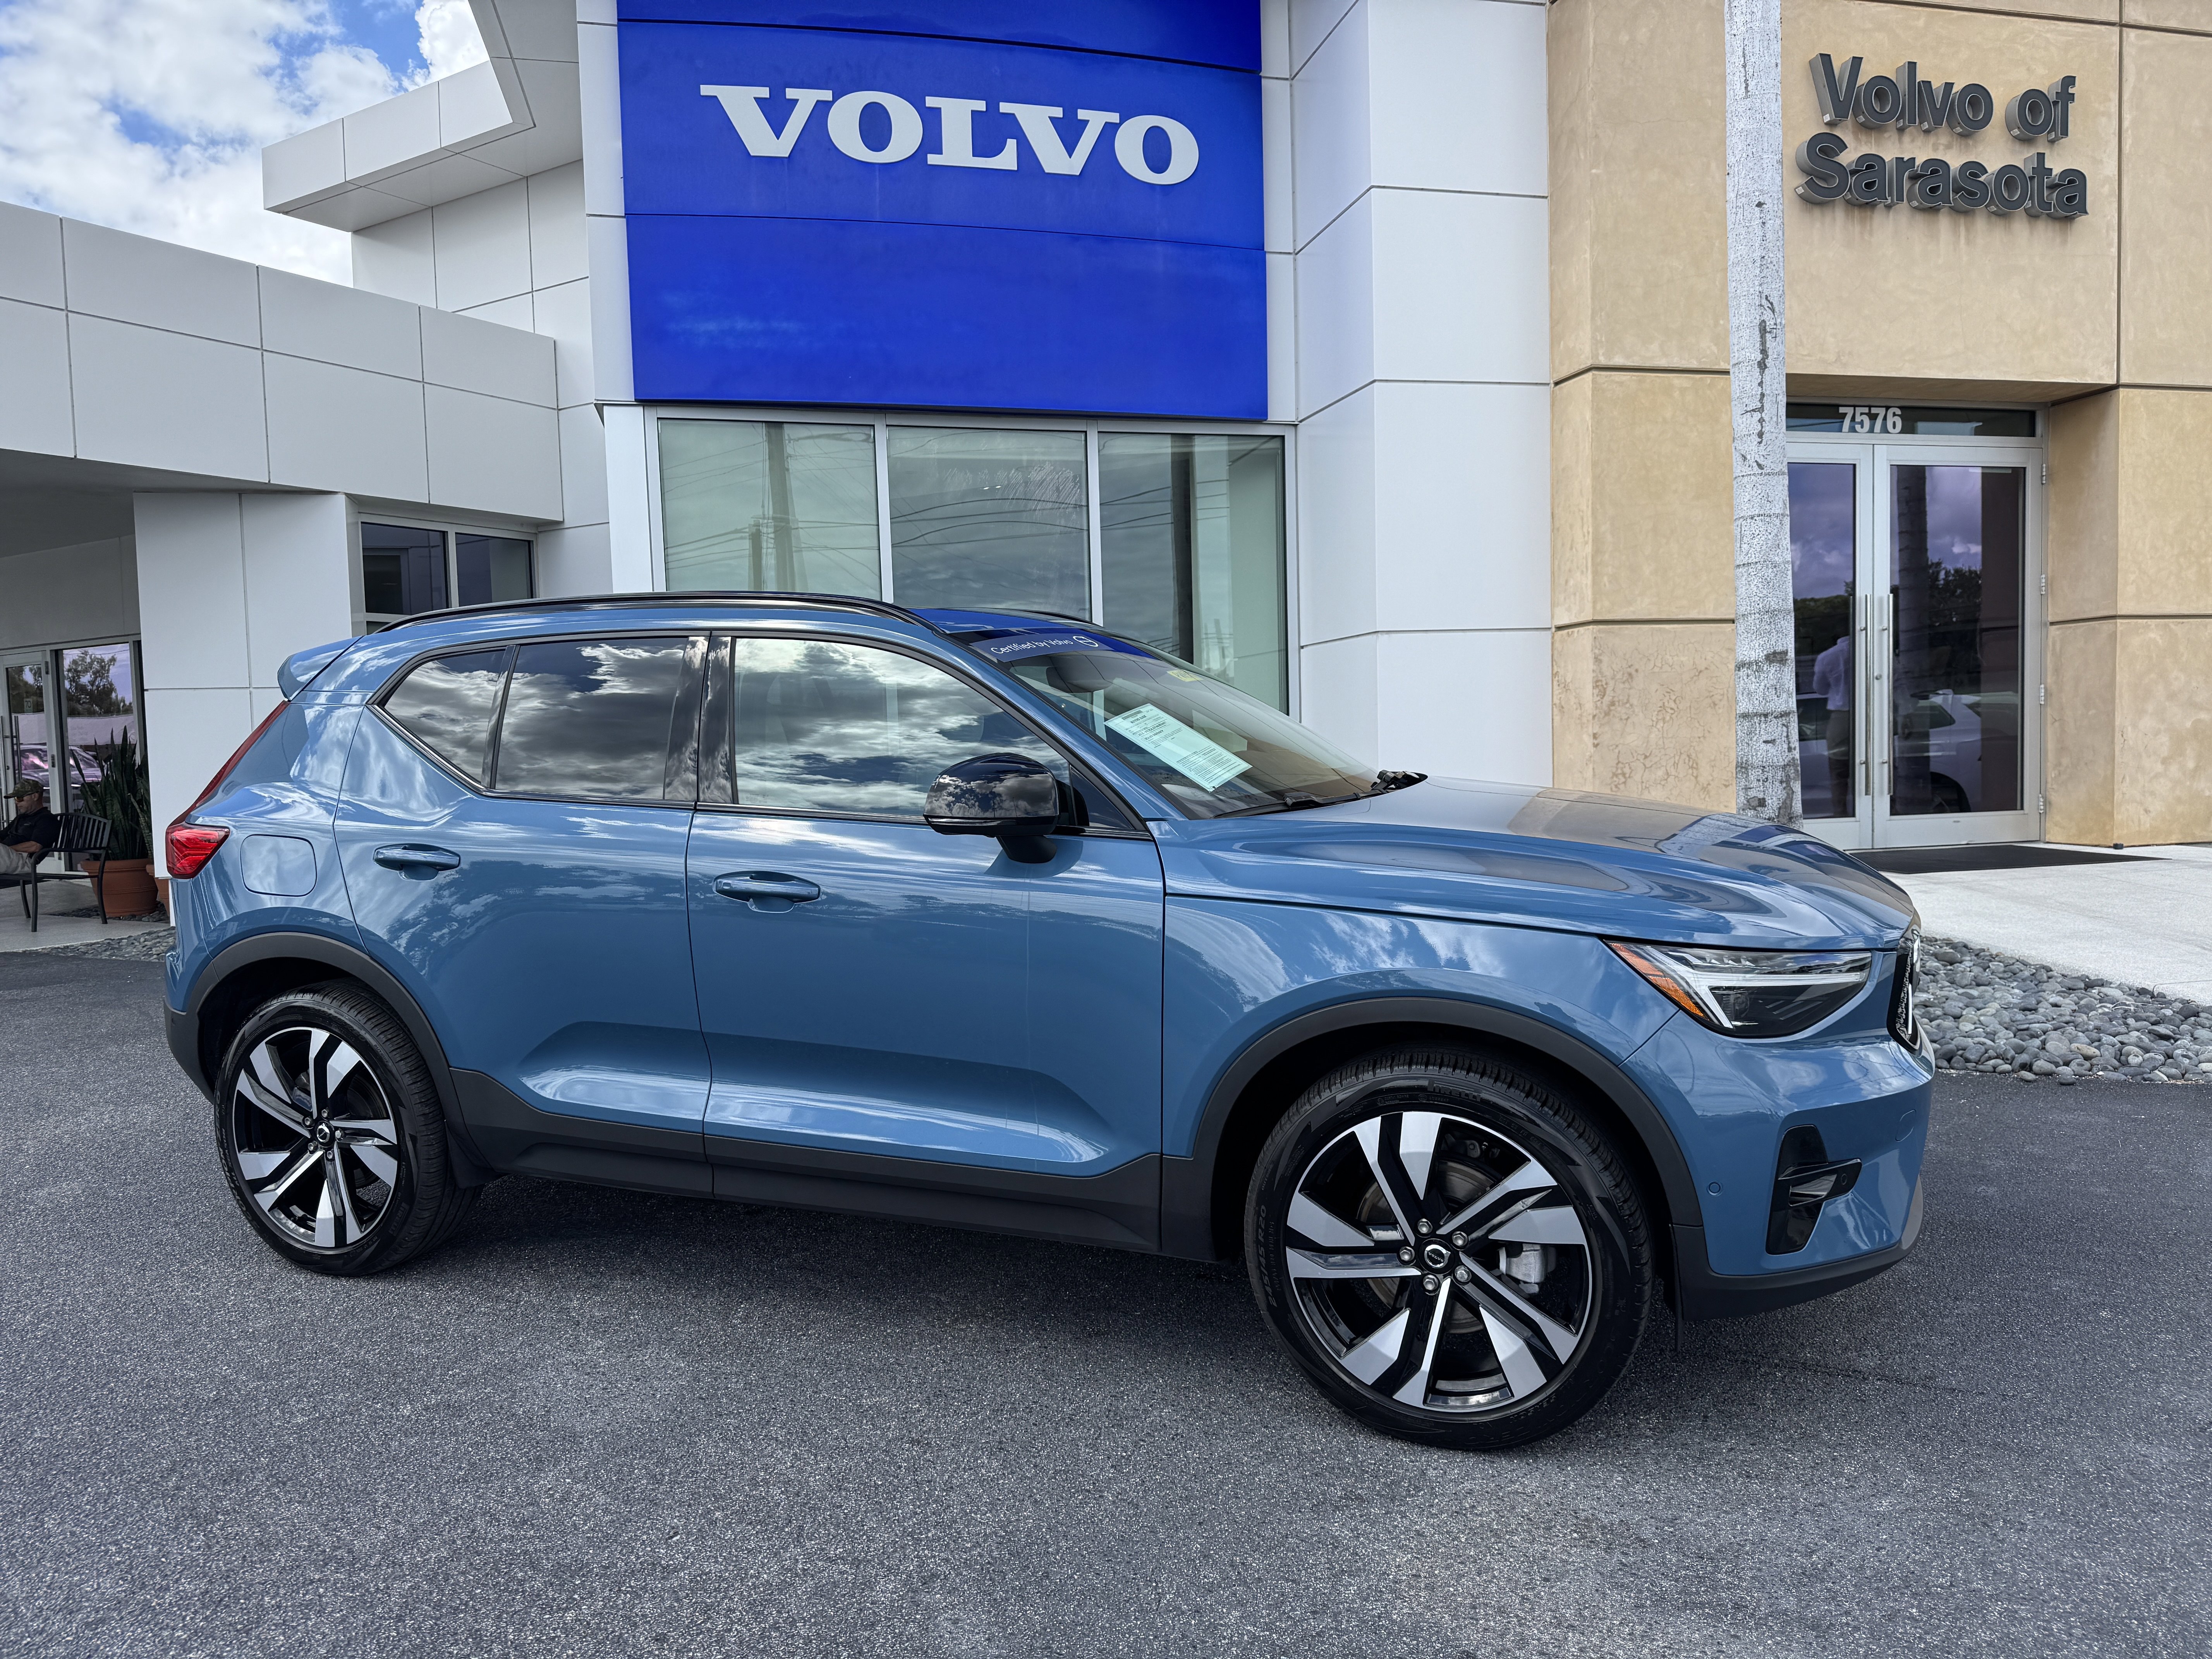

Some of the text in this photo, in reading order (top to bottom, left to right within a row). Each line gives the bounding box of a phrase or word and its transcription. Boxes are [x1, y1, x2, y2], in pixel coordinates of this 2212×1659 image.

[1809, 53, 2076, 143] Volvo of
[700, 84, 1199, 185] VOLVO
[1794, 132, 2089, 220] Sarasota
[1838, 407, 1902, 434] 7576
[991, 642, 1036, 654] Certified
[1427, 1079, 1482, 1103] PIRELLI
[1258, 1205, 1266, 1243] R20
[1259, 1244, 1278, 1307] 245/45
